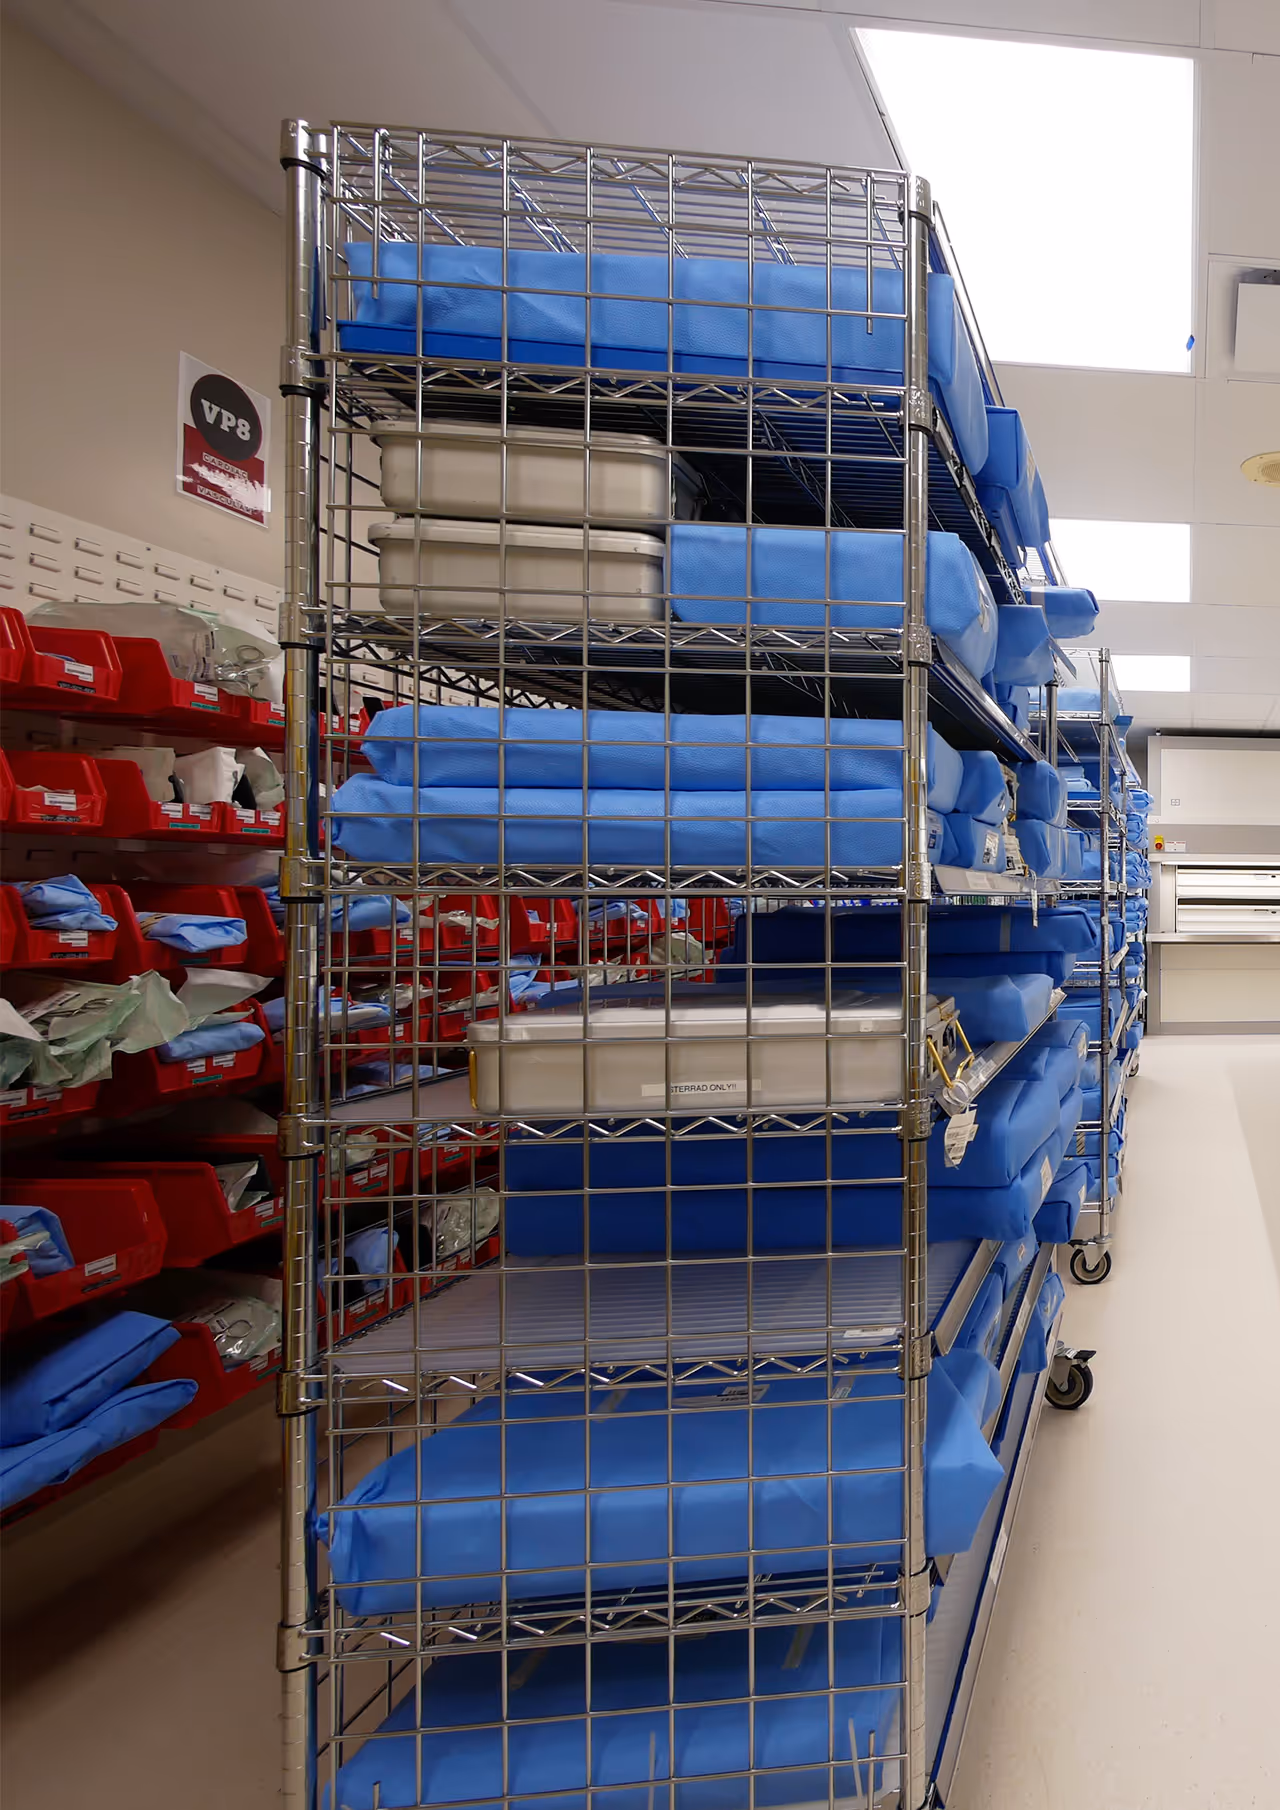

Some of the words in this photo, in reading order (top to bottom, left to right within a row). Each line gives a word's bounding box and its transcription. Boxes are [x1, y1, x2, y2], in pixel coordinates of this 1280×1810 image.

[200, 398, 251, 442] VP8
[203, 453, 249, 479] CARDIAC
[709, 1084, 737, 1092] ONLY!!
